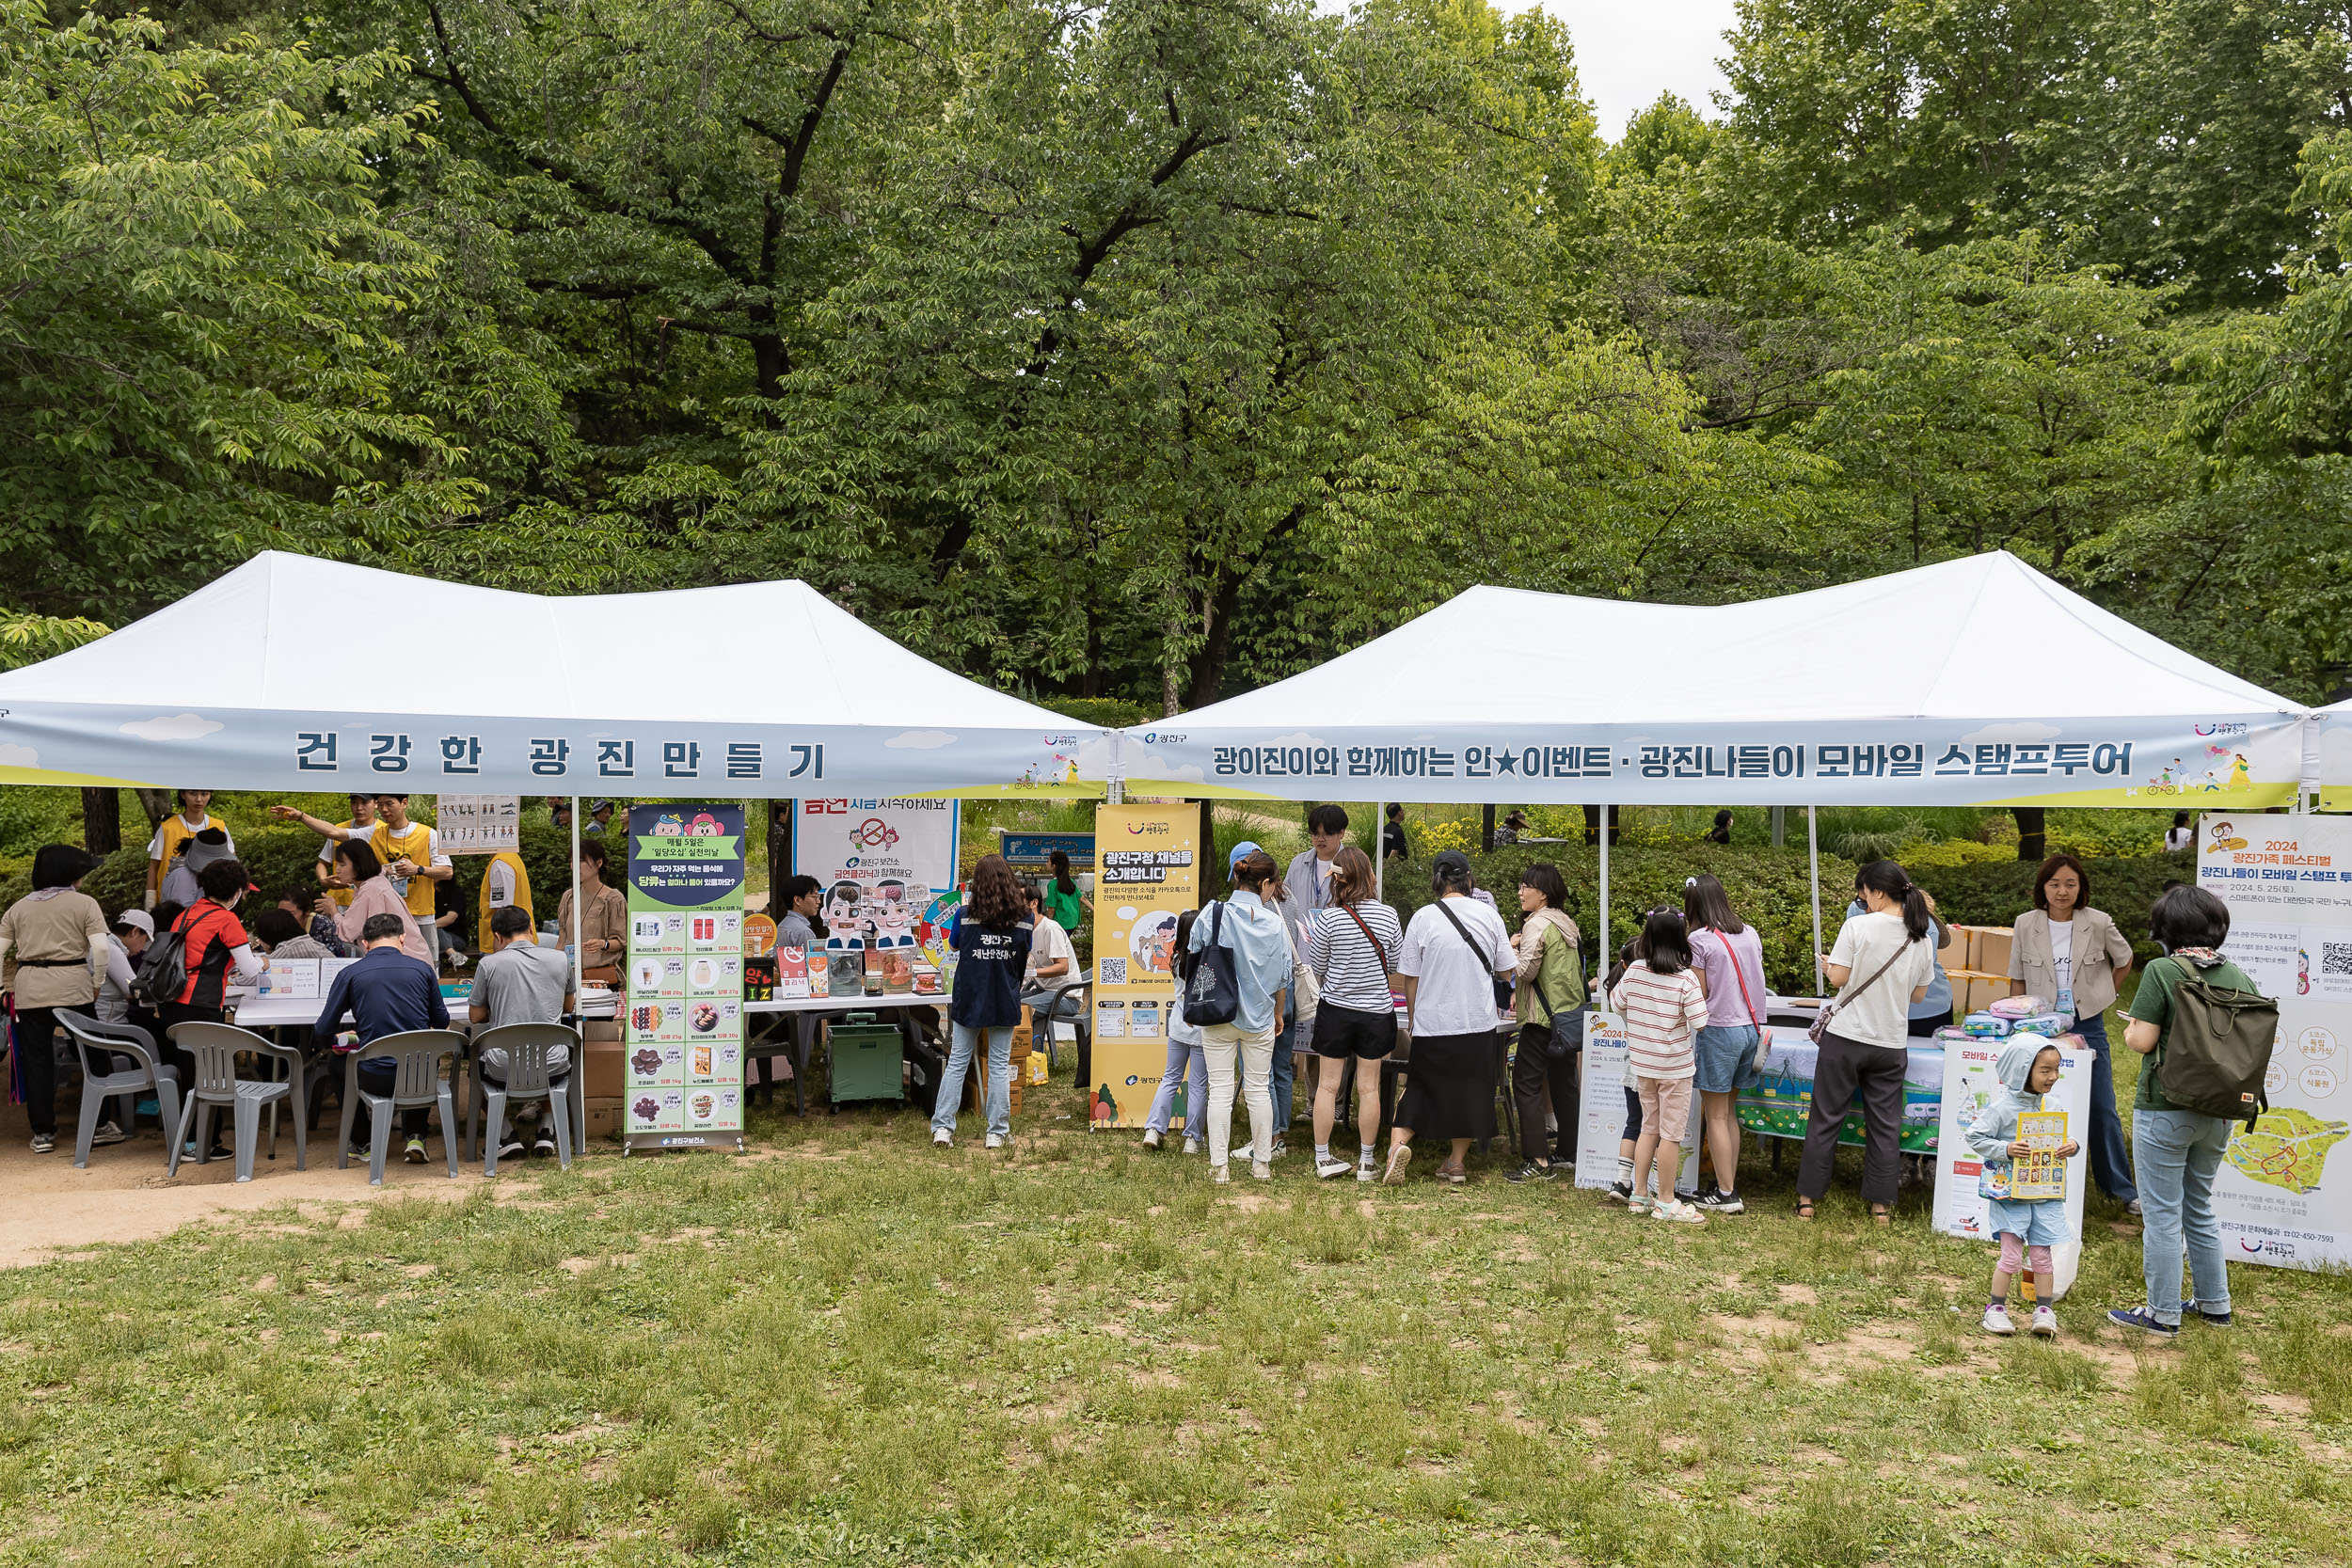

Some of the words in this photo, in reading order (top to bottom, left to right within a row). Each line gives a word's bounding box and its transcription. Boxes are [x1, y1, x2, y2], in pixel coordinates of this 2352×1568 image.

[1159, 734, 1187, 743] 광진구
[1213, 746, 1340, 777] 광이진이와
[1346, 746, 1456, 779] 함께하는
[1639, 745, 1804, 779] 광진나들이
[1816, 742, 1923, 779] 모바일
[1933, 742, 2134, 778] 스탬프투어
[2265, 841, 2298, 852] 2024
[1106, 851, 1154, 864] 광진구청
[1157, 851, 1192, 864] 채널을
[2233, 853, 2279, 865] 광진가족
[2283, 855, 2331, 866] 페스티벌
[1106, 867, 1166, 880] 소개합니다
[2201, 867, 2258, 879] 광진나들이
[2262, 869, 2297, 881] 모바일
[2300, 871, 2337, 882] 스탬프
[639, 876, 666, 886] 당류는
[1962, 1051, 1987, 1061] 모바일
[2307, 1080, 2329, 1088] 식물원
[2221, 1221, 2246, 1232] 광진구청
[2248, 1225, 2280, 1236] 문화예술과
